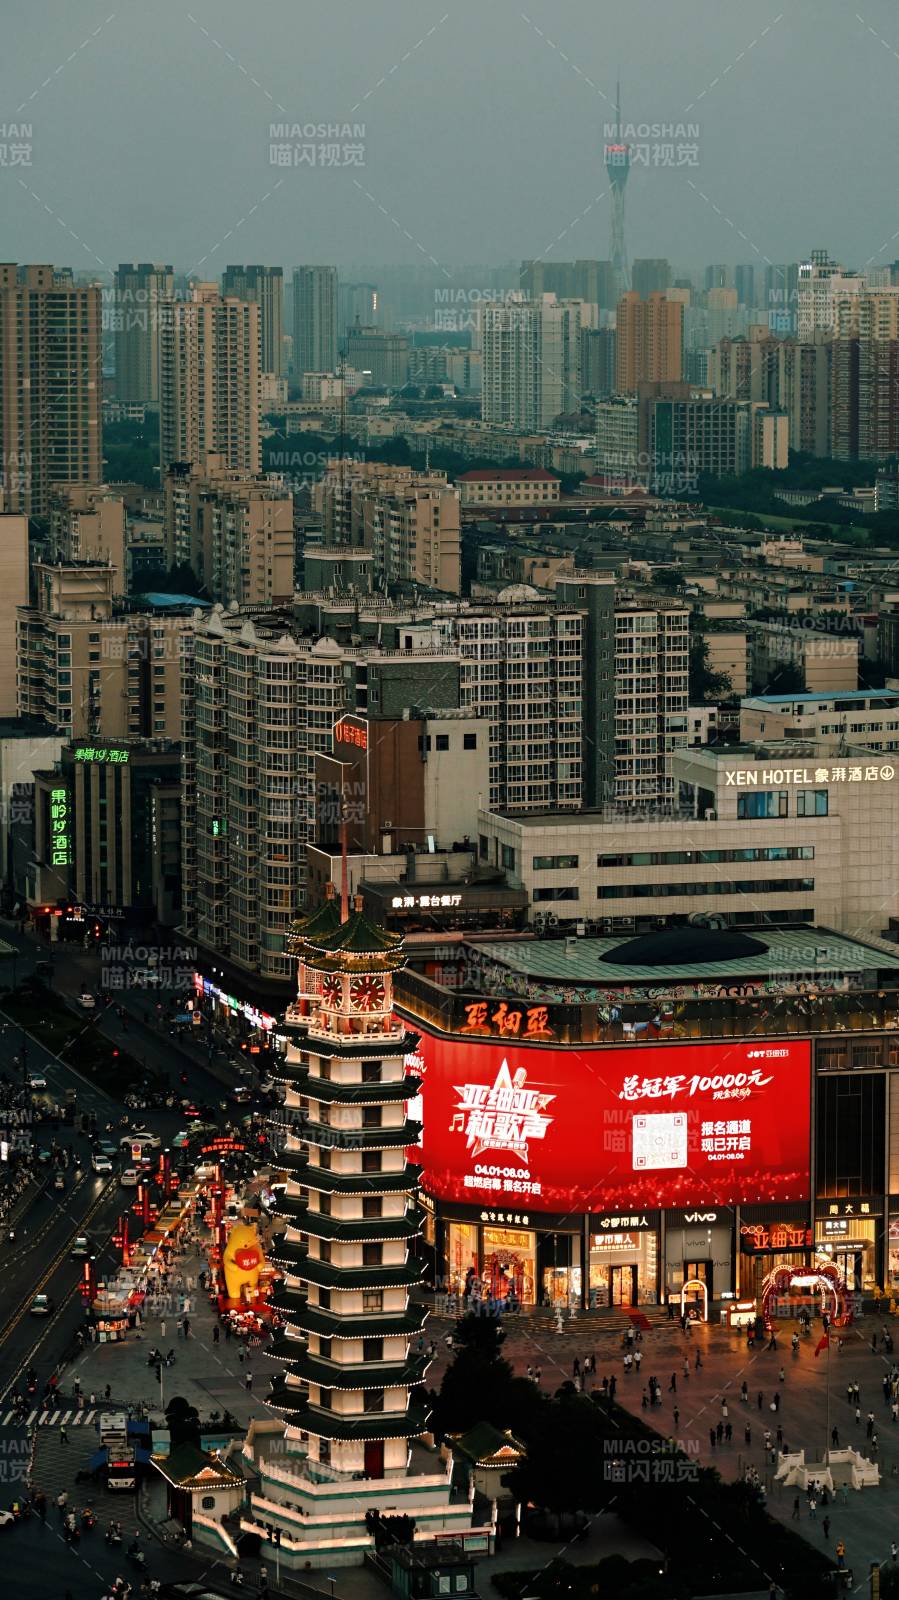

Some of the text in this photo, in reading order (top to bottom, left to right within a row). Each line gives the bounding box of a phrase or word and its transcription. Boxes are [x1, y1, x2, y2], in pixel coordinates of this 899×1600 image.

[725, 766, 879, 786] XEN HOTEL 象湃酒店
[459, 1083, 541, 1115] 亚细亚
[712, 1087, 752, 1102] 现金奖励
[464, 1110, 555, 1145] 新歌声
[700, 1120, 752, 1136] 报名通道
[700, 1136, 751, 1152] 现已开启
[707, 1152, 745, 1161] 04.01-08.06
[474, 1164, 531, 1180] 04.01-08.06
[463, 1175, 542, 1195] 超燃启幕 报名开启
[684, 1211, 717, 1223] vivo
[829, 1203, 870, 1215] 周大福
[610, 1215, 649, 1228] 都市丽人
[825, 1221, 847, 1230] 周大福
[594, 1233, 633, 1246] 都市丽人
[753, 1230, 805, 1249] 亚细亚
